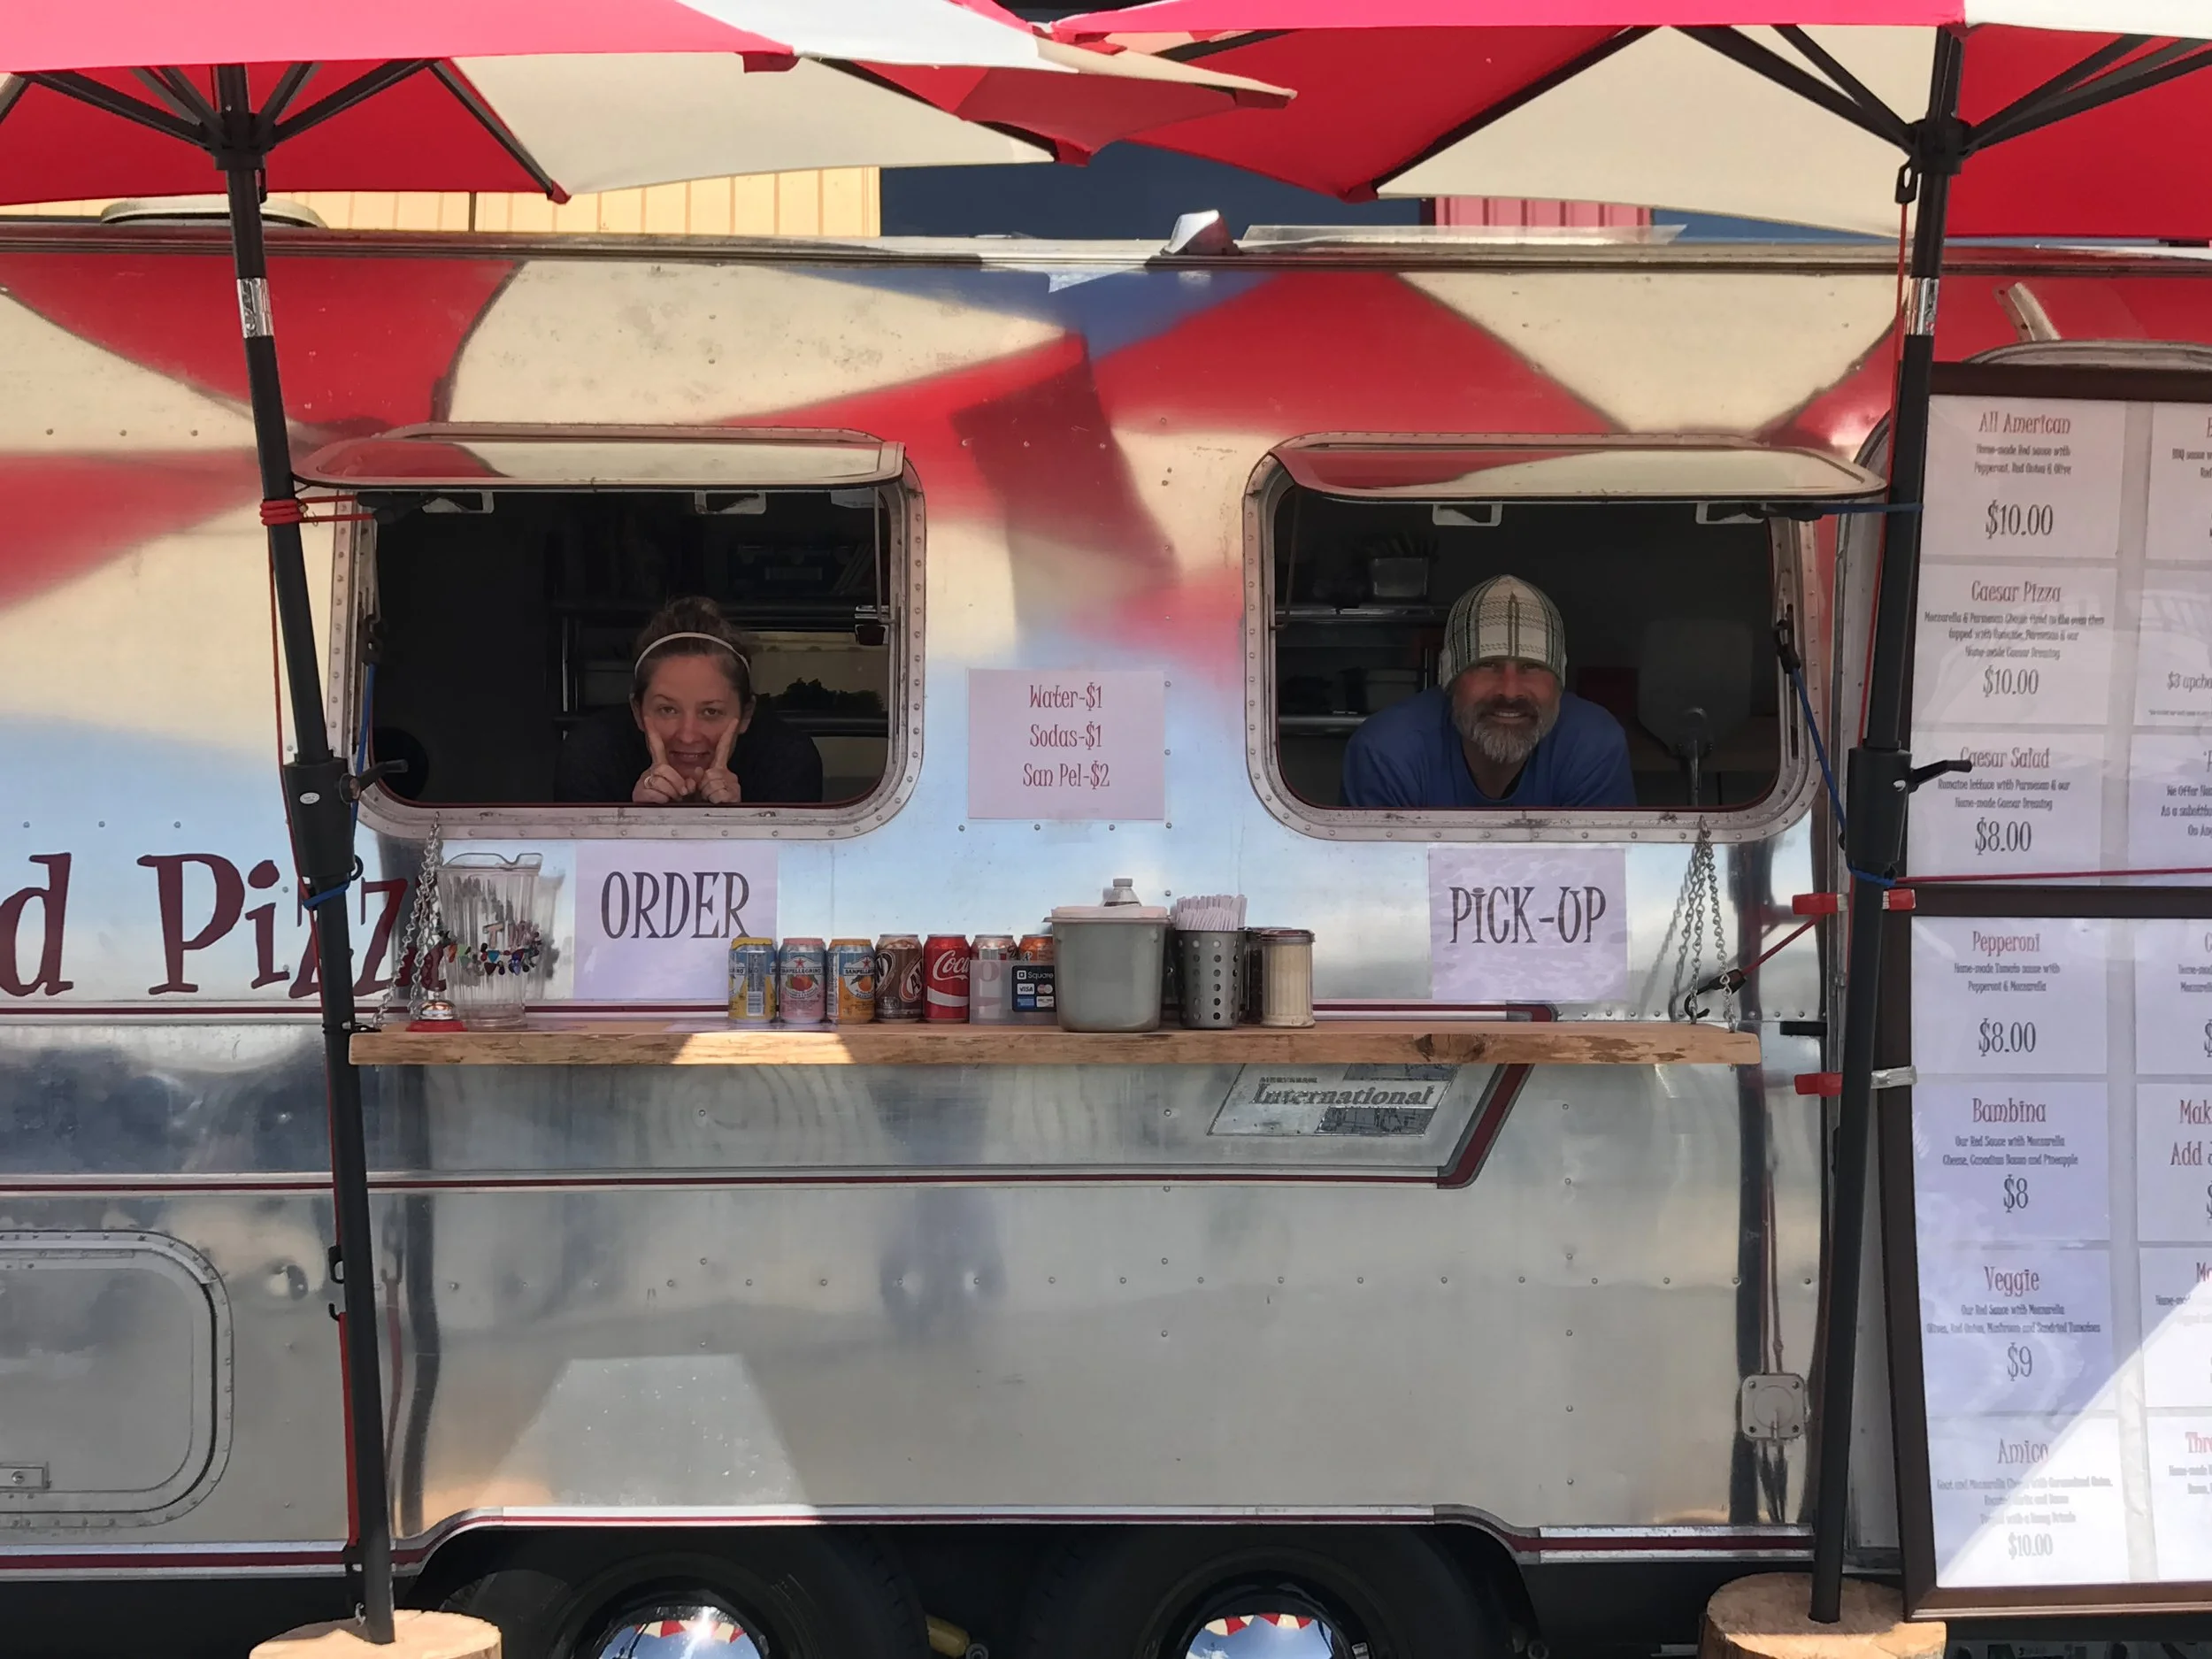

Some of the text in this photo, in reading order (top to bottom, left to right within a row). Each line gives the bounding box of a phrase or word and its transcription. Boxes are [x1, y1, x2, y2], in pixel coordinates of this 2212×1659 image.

[1978, 411, 2071, 434] All American
[1985, 499, 2054, 541] $10.00
[1971, 580, 2062, 603] Caesar Pizza
[1983, 664, 2039, 697] $10.00
[1029, 681, 1103, 711] Water-$1
[1029, 720, 1102, 750] Sodas-$1
[2010, 747, 2052, 769] Salad
[1023, 759, 1110, 790] San Pel-$2
[1996, 780, 2014, 790] with
[1975, 817, 2032, 856] $8.00
[600, 870, 751, 940] ORDER
[1971, 931, 2041, 956] Pepperoni
[1978, 1018, 2037, 1056] $8.00
[1249, 1082, 1435, 1106] International
[1971, 1097, 2047, 1123] Bambina
[2170, 1141, 2202, 1166] Add
[2003, 1174, 2029, 1213] $8
[1984, 1266, 2040, 1297] Veggie
[2007, 1342, 2032, 1382] $9
[1997, 1438, 2048, 1464] Amico
[2008, 1532, 2054, 1560] $10.00
